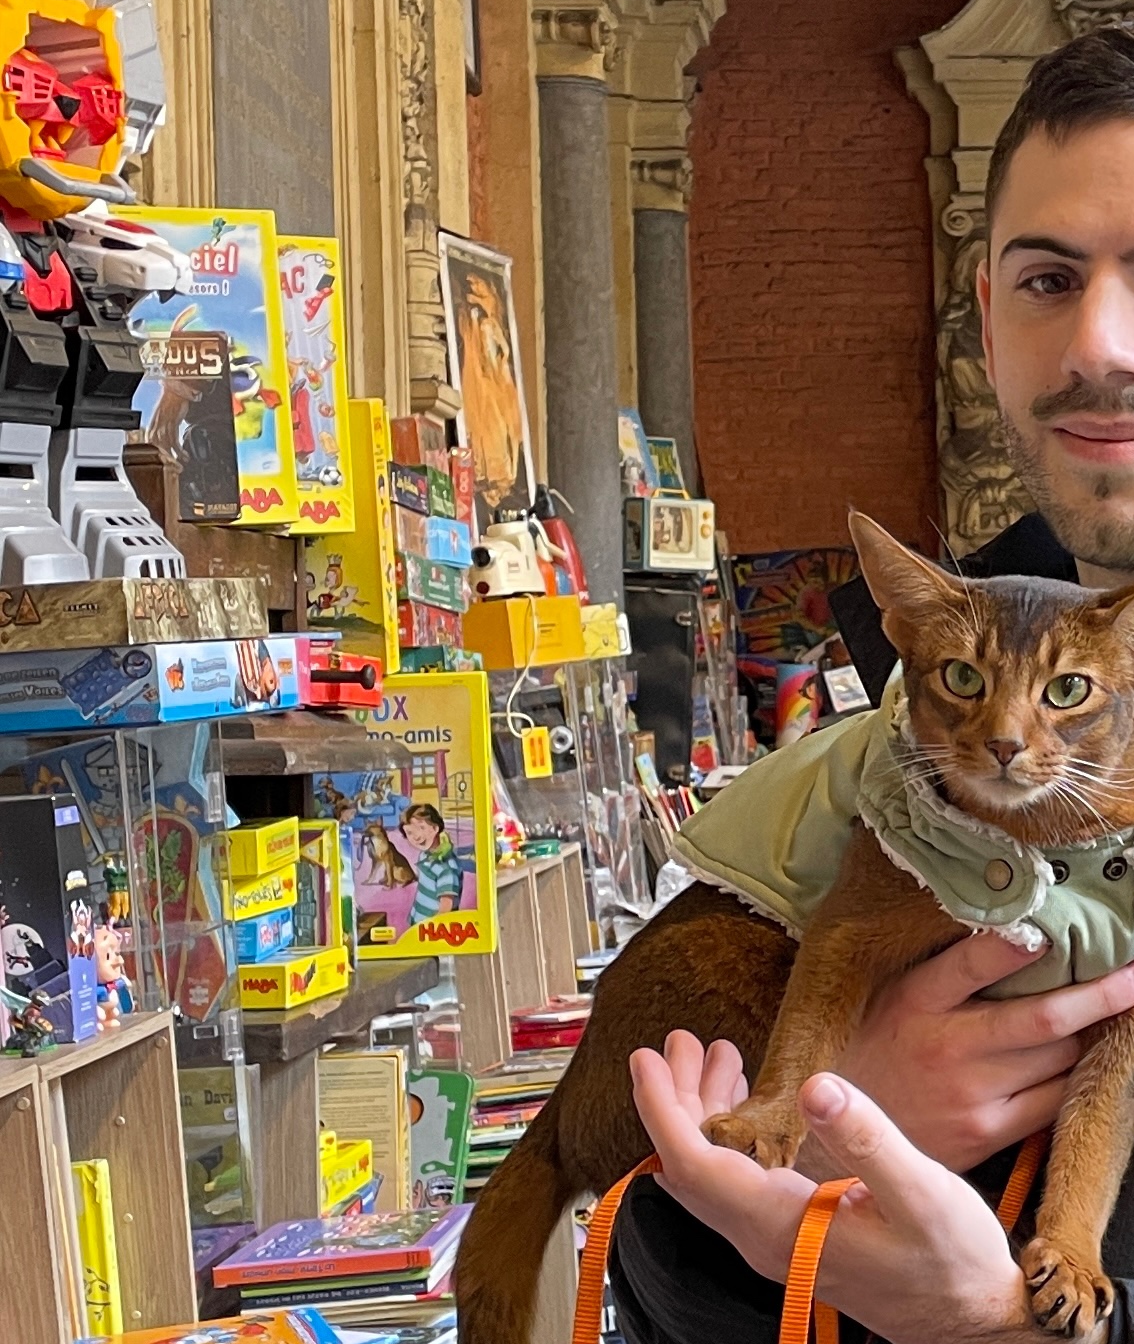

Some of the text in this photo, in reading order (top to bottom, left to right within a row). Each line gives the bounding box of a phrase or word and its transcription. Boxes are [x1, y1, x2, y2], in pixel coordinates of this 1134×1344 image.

[140, 339, 222, 375] ADOS
[239, 488, 283, 513] ABA
[301, 501, 341, 524] ABA
[418, 922, 479, 947] HABA
[242, 978, 279, 994] HABA
